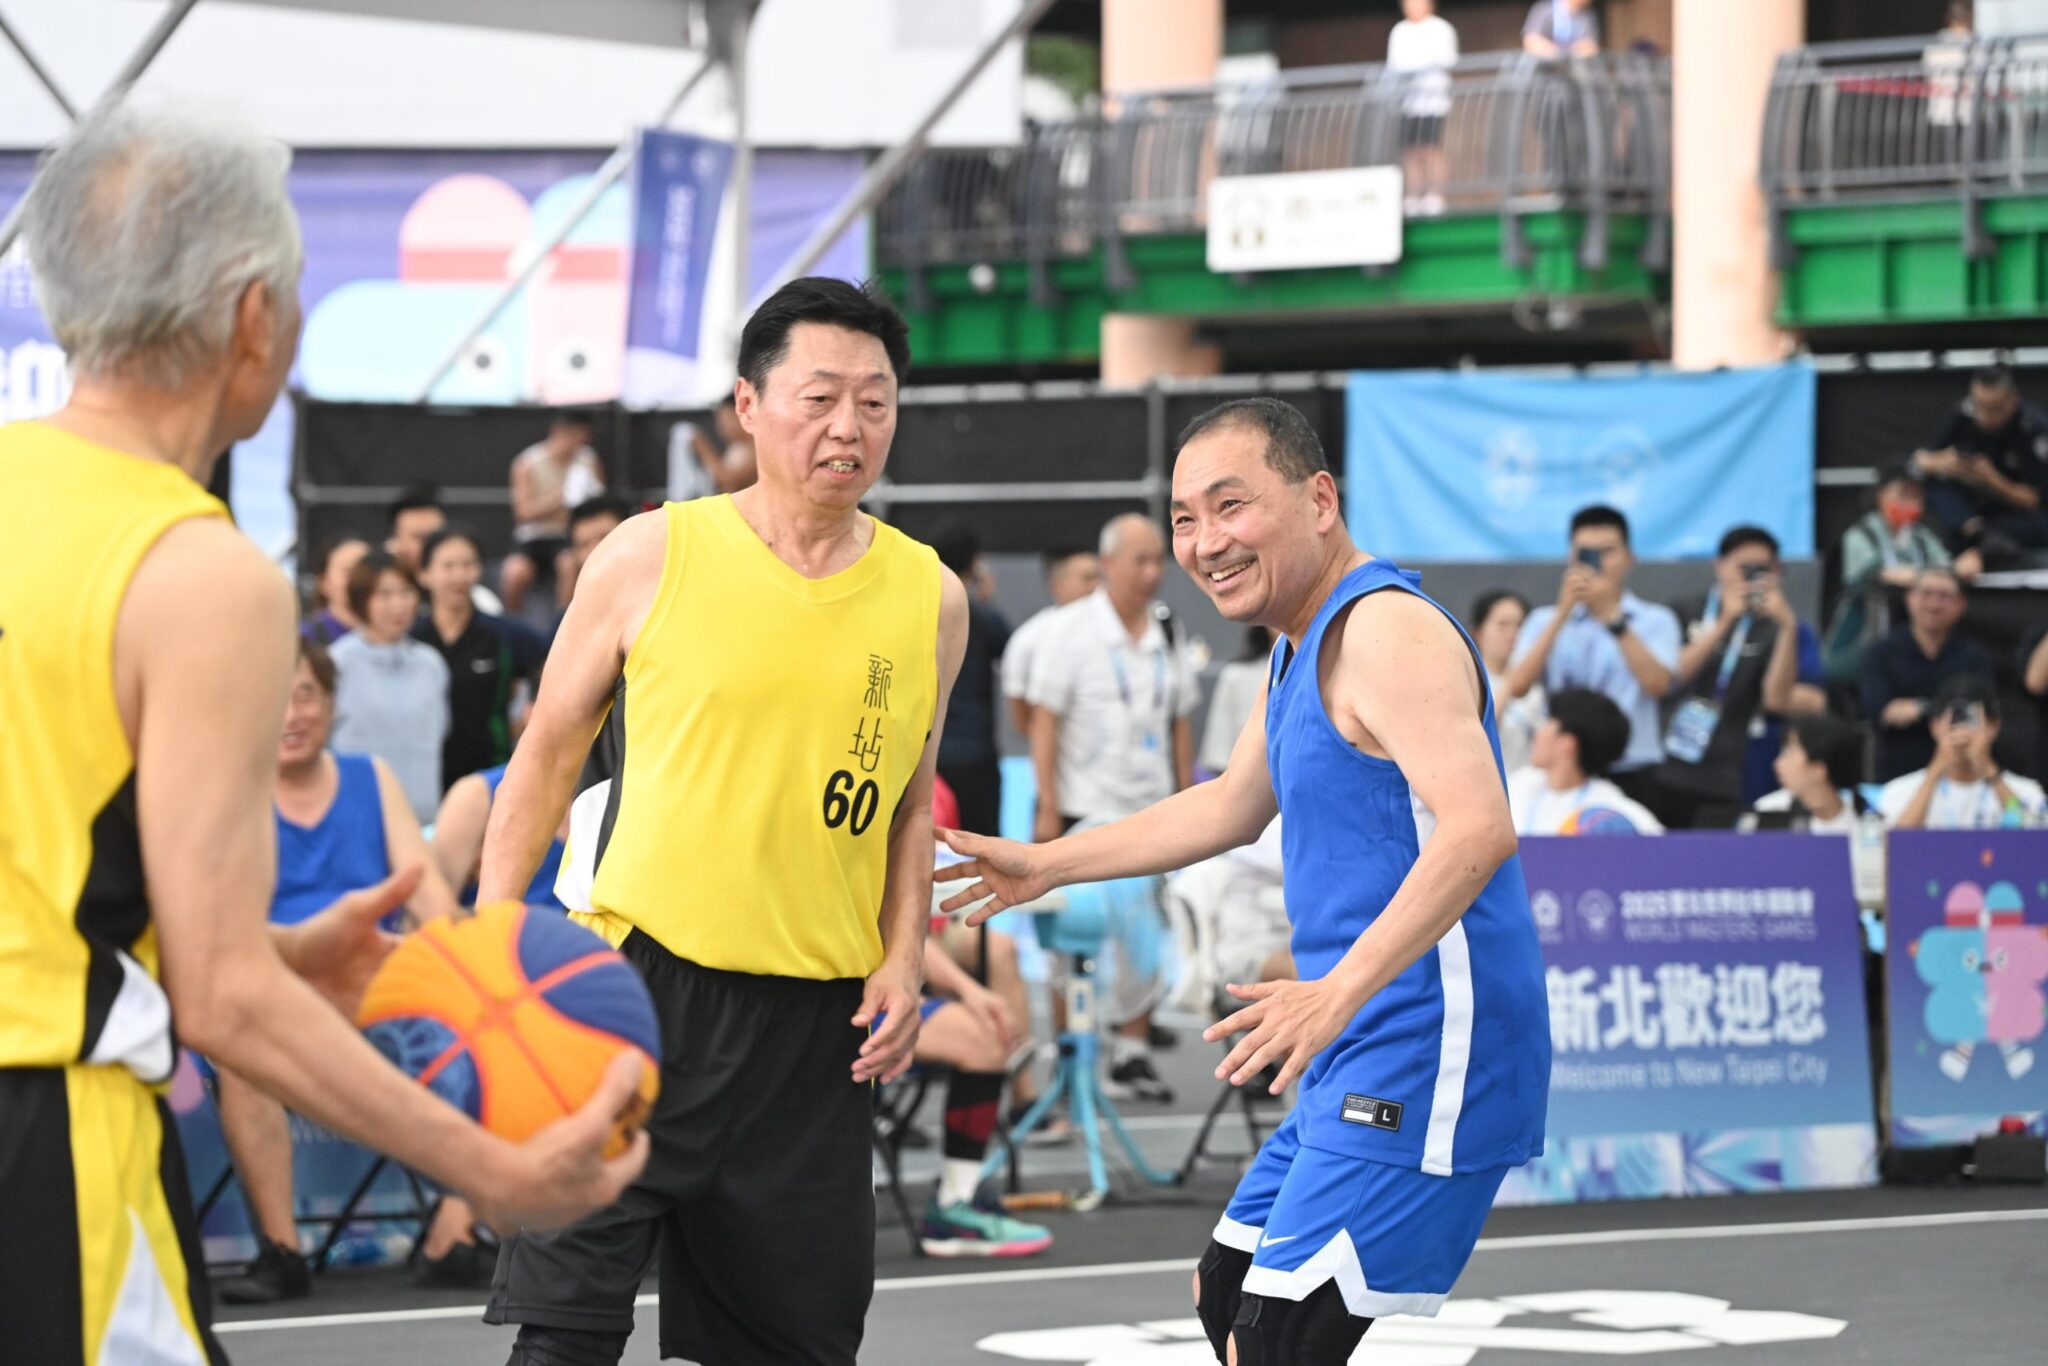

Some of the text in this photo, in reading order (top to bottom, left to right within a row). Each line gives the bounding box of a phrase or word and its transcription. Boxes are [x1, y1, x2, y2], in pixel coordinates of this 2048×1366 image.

[823, 769, 879, 837] 60
[1546, 961, 1826, 1052] 新北歡迎您
[1650, 1061, 1673, 1087] to
[1675, 1056, 1722, 1084] New
[1726, 1053, 1783, 1087] Taipei
[1787, 1052, 1829, 1086] City
[1382, 1108, 1391, 1121] L
